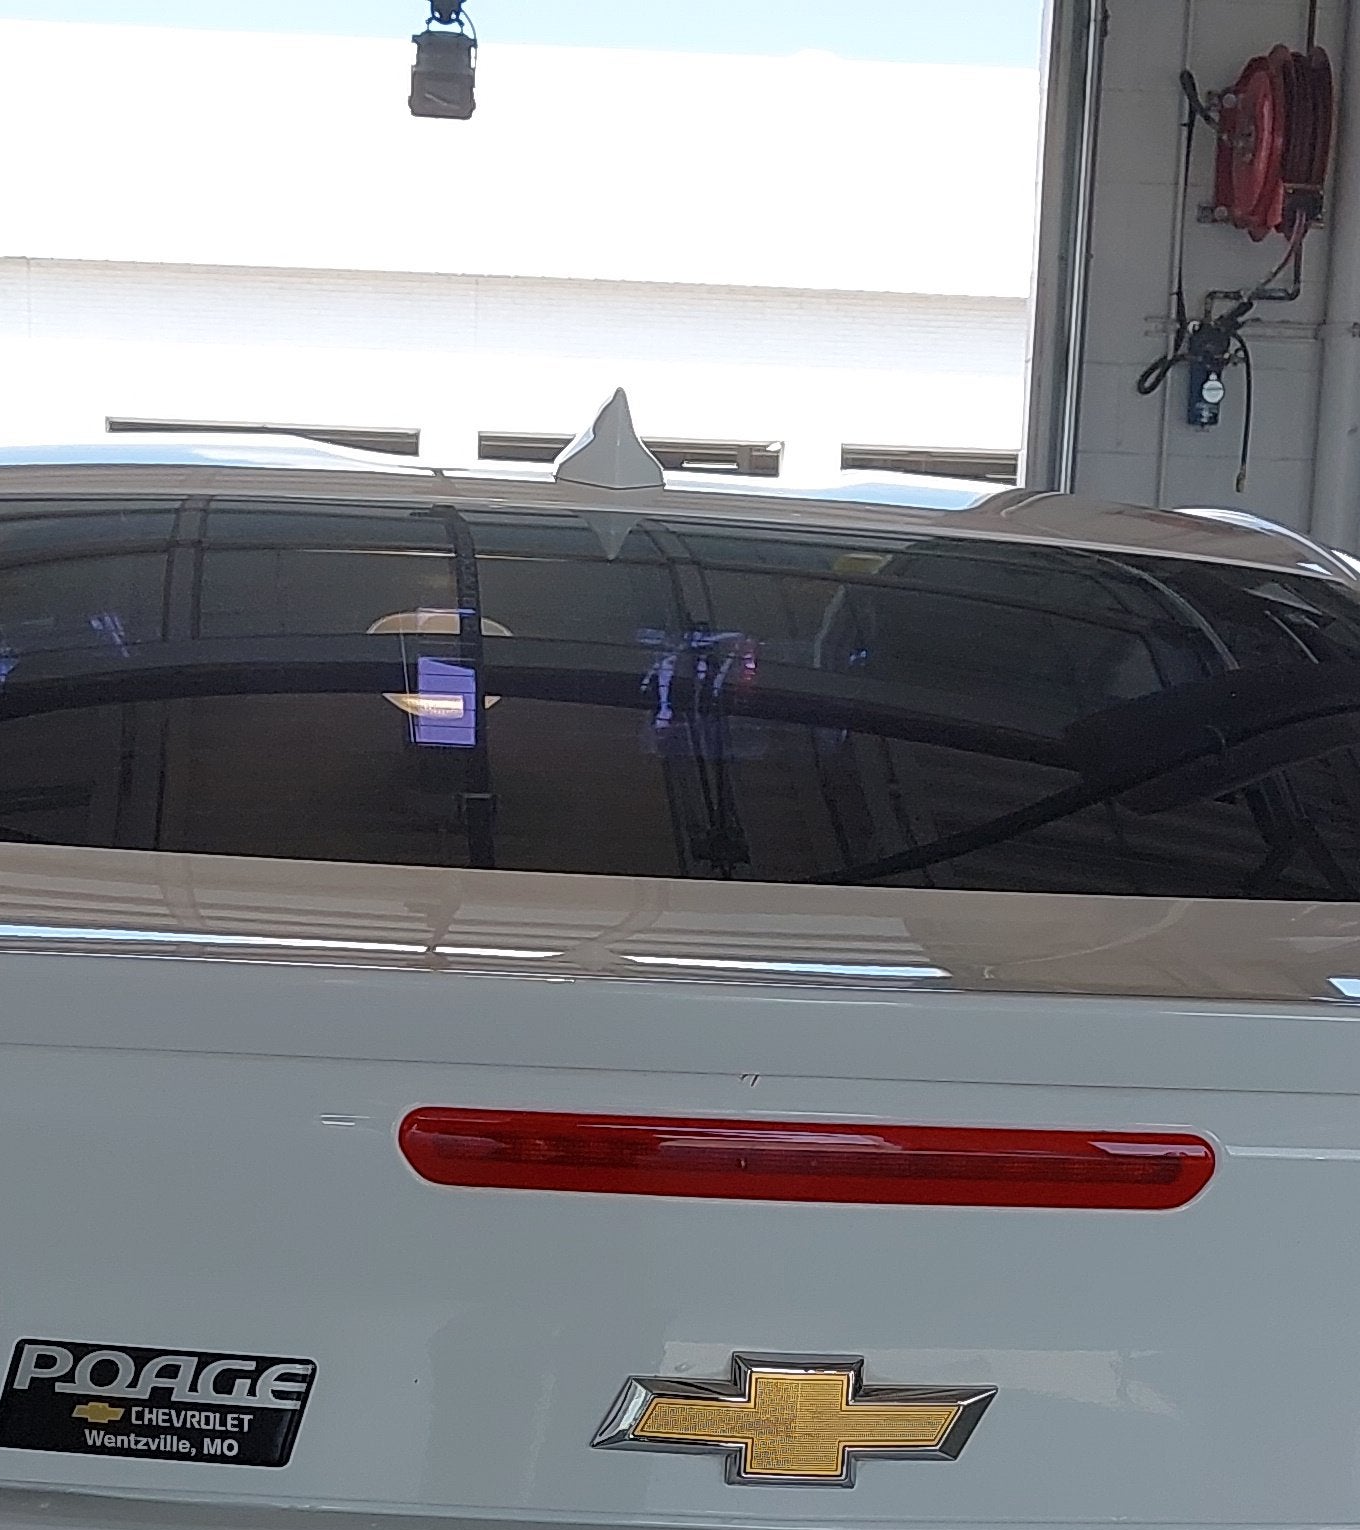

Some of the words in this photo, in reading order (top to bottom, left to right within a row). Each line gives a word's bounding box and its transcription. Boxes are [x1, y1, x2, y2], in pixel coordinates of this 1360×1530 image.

[12, 1344, 316, 1410] POAGE
[130, 1406, 254, 1433] CHEVROLET
[83, 1428, 197, 1456] Wentzville,
[202, 1437, 240, 1457] MO
